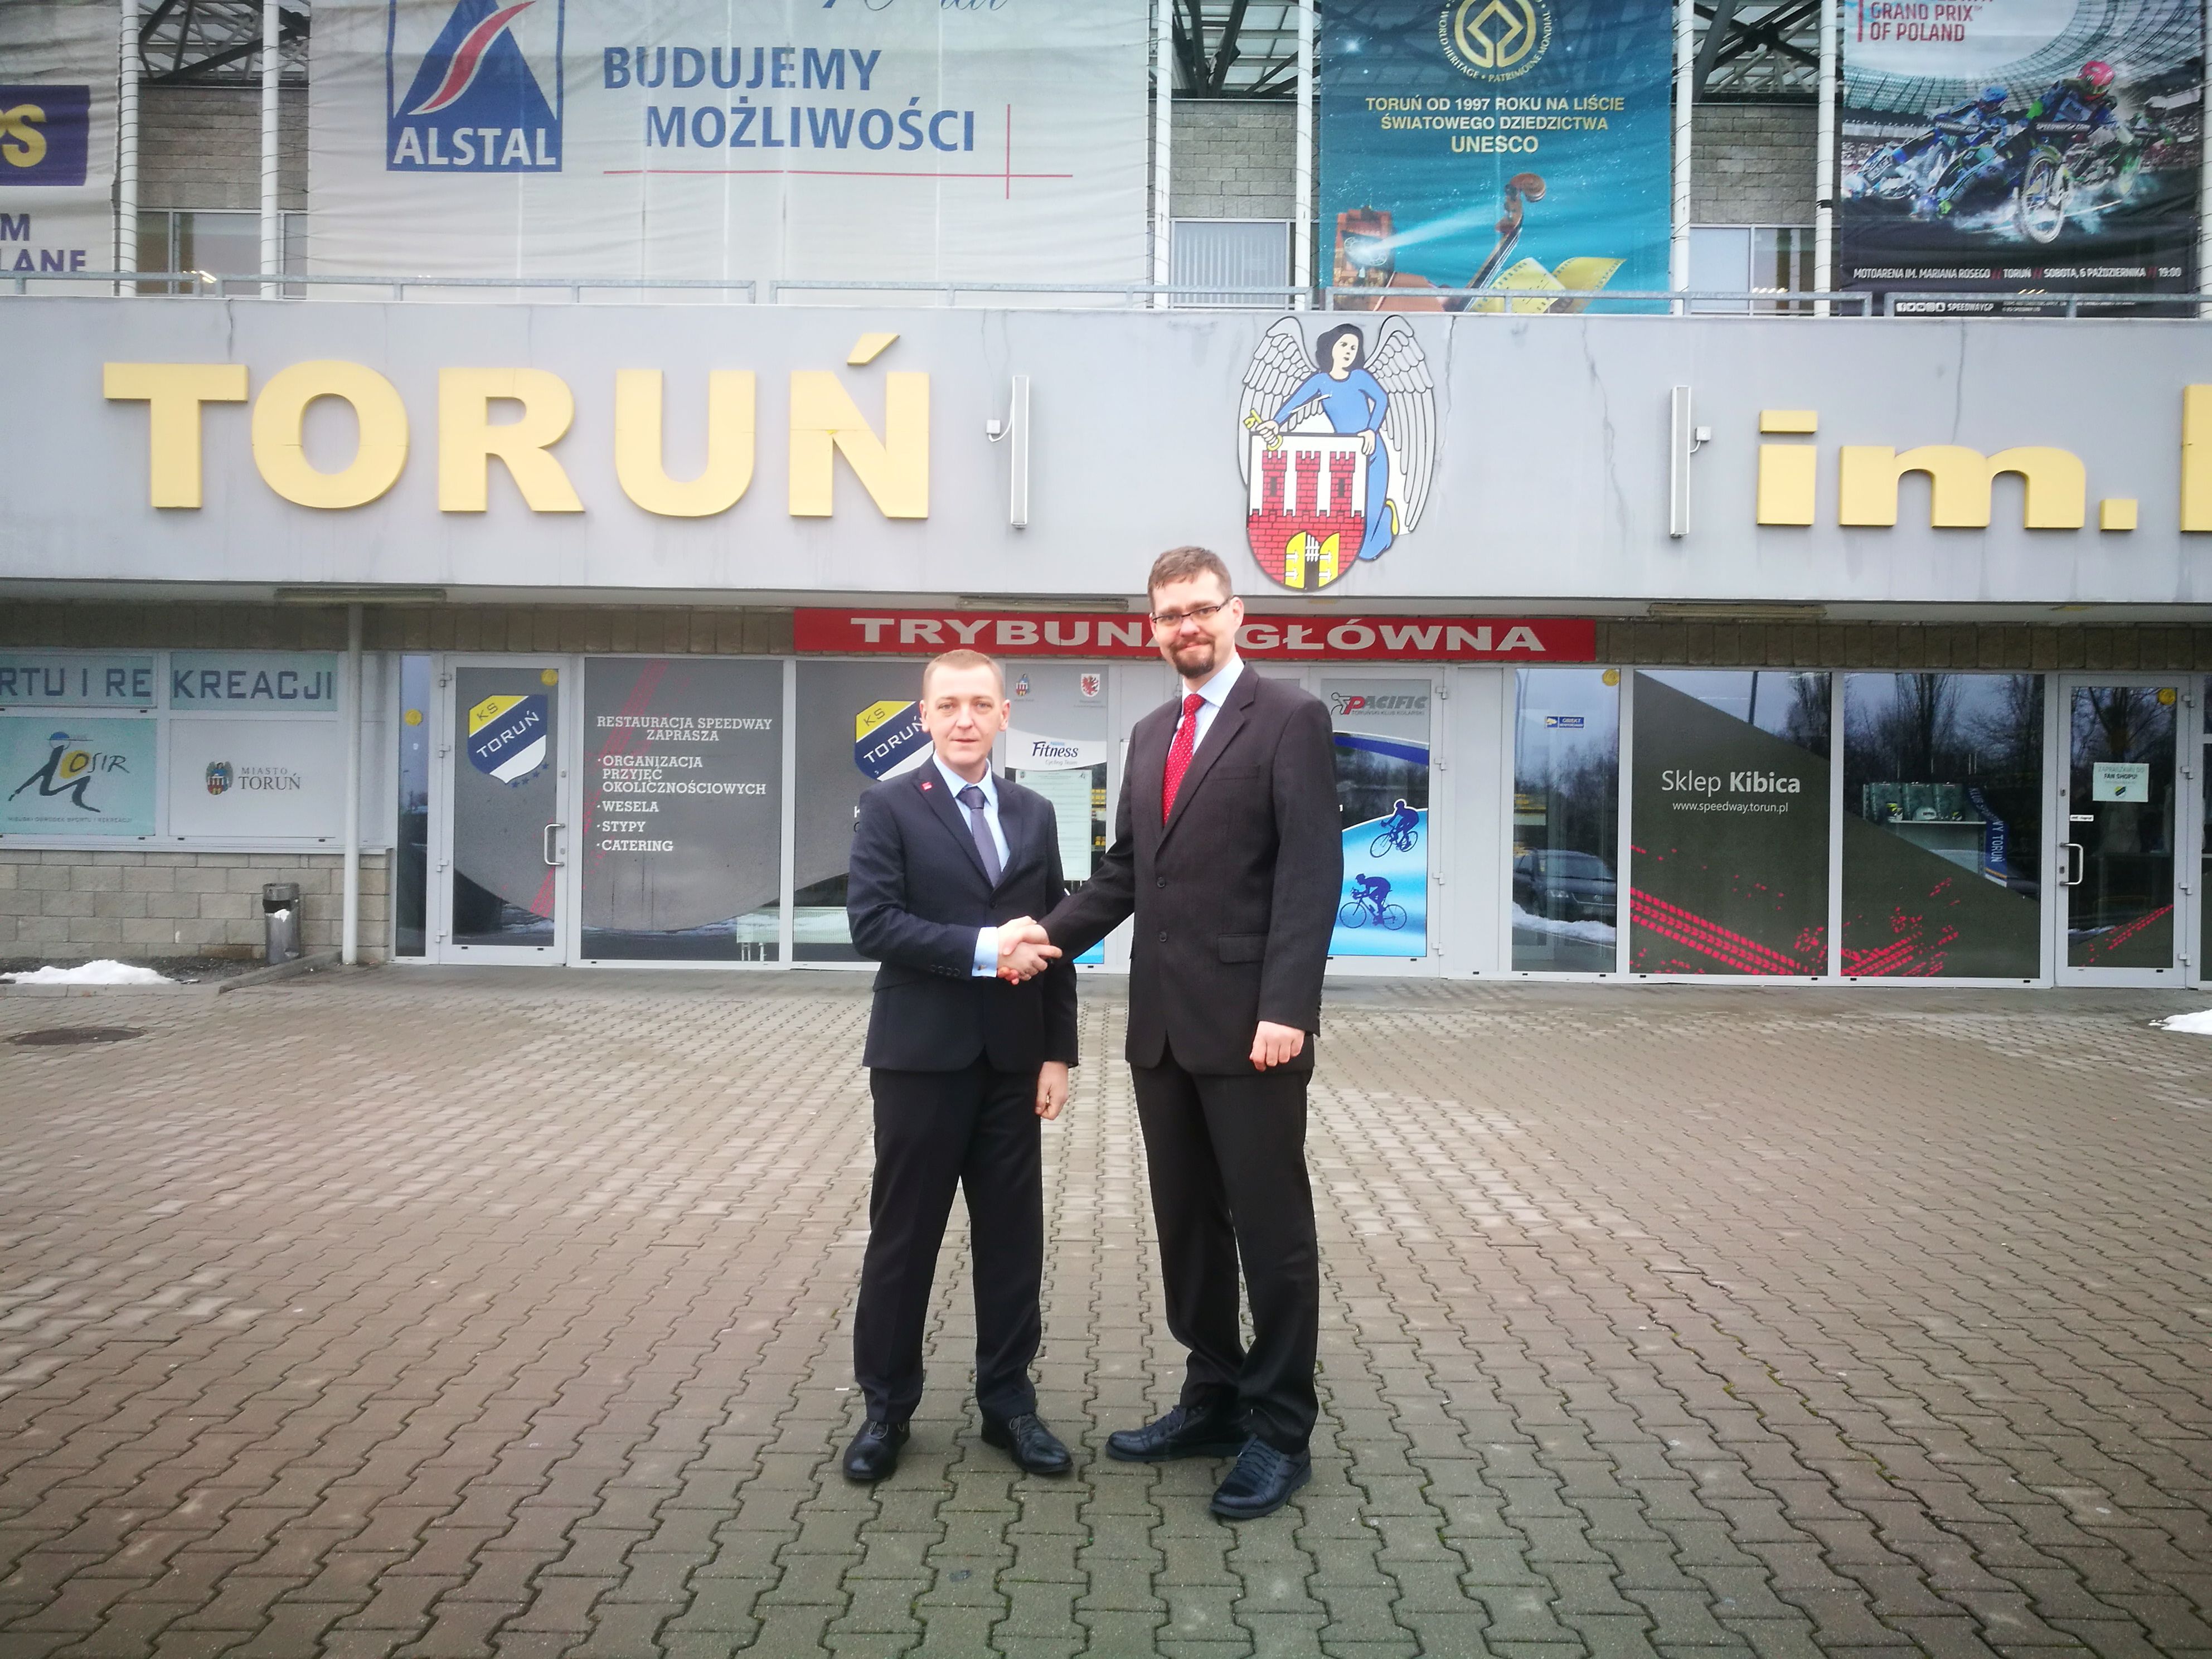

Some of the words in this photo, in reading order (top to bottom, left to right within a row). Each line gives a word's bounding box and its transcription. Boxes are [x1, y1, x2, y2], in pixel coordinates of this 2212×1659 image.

[1871, 2, 1929, 21] GRAND
[1870, 22, 1891, 41] OF
[1896, 22, 1965, 42] POLAND
[604, 47, 882, 91] BUDUJEMY
[1443, 46, 1479, 80] HERITAGE
[1365, 94, 1422, 111] TORUŃ
[1426, 98, 1451, 111] OD
[1455, 98, 1490, 111] 1997
[1495, 97, 1541, 111] ROKU
[1546, 98, 1569, 111] NA
[1573, 94, 1625, 111] LIŚCIE
[646, 96, 975, 152] MOŻLIWOŚCI
[1380, 113, 1495, 130] ŚWIATOWEGO
[1500, 116, 1609, 130] DZIEDZICTWA
[394, 127, 556, 166] ALSTAL
[1451, 135, 1539, 153] UNESCO
[1853, 268, 1904, 279] MOTOARENA
[1919, 268, 1957, 279] MARIANA
[2003, 266, 2032, 279] TORUŃ
[104, 333, 930, 518] TORUŃ
[1757, 409, 2138, 532] im.
[851, 617, 1160, 648] TRYBUN
[1234, 619, 1546, 652] GŁÓWNA
[82, 668, 88, 697] I
[477, 702, 498, 721] KS
[1344, 696, 1429, 715] PACIFIC
[597, 716, 694, 729] RESTAURACJA
[698, 717, 773, 730] SPEEDWAY
[864, 708, 885, 726] KS
[476, 710, 540, 758] TORUŃ
[647, 729, 720, 741] ZAPRASZA
[1032, 741, 1079, 758] Fitness
[603, 755, 703, 769] ORGANIZACJA
[238, 773, 302, 790] TORUŃ
[603, 766, 662, 781] PRZYJĘĆ
[603, 780, 767, 795] OKOLICZNOŚCIOWYCH
[1661, 770, 1722, 797] Sklep
[1729, 771, 1801, 794] Kibica
[602, 801, 659, 812] WESELA
[1672, 801, 1789, 814] www.speedway.torun.pl
[602, 821, 646, 832] STYPY
[601, 839, 674, 852] CATERING
[1991, 835, 2006, 863] TORUŃ
